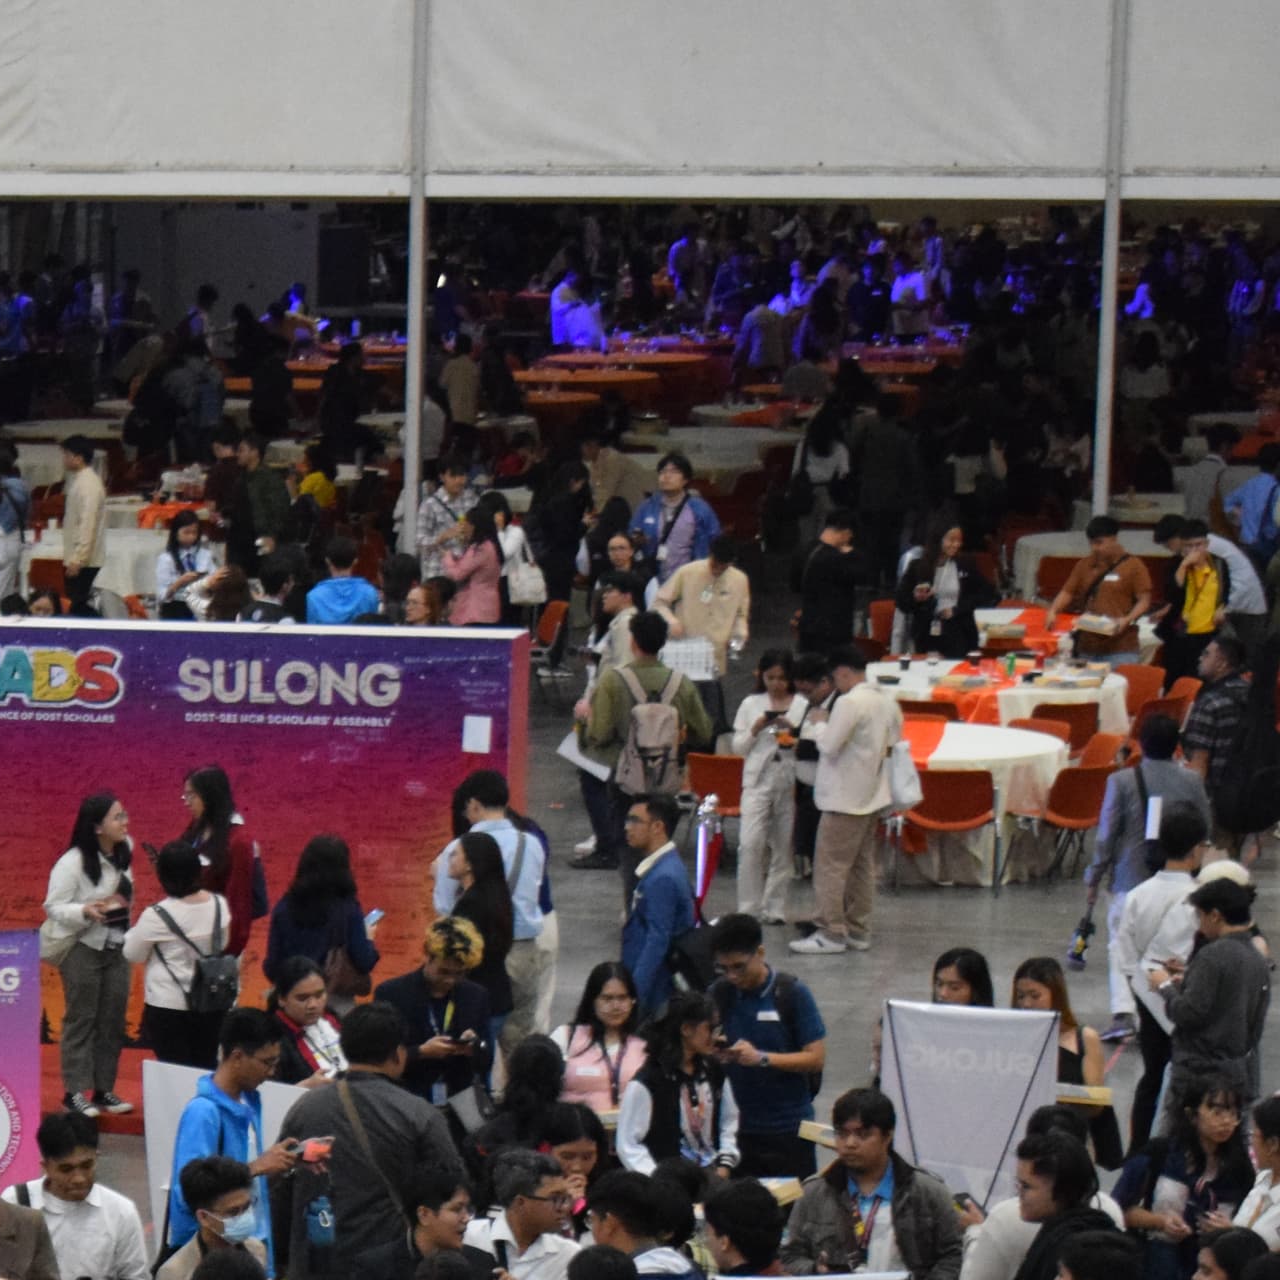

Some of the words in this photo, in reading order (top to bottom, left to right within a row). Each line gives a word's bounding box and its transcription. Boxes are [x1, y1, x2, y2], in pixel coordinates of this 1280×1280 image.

[178, 658, 401, 707] SULONG
[20, 712, 34, 721] OF
[36, 713, 61, 721] DOST
[63, 713, 115, 723] SCHOLARS
[333, 716, 391, 727] ASSEMBLY
[10, 1111, 21, 1132] AND
